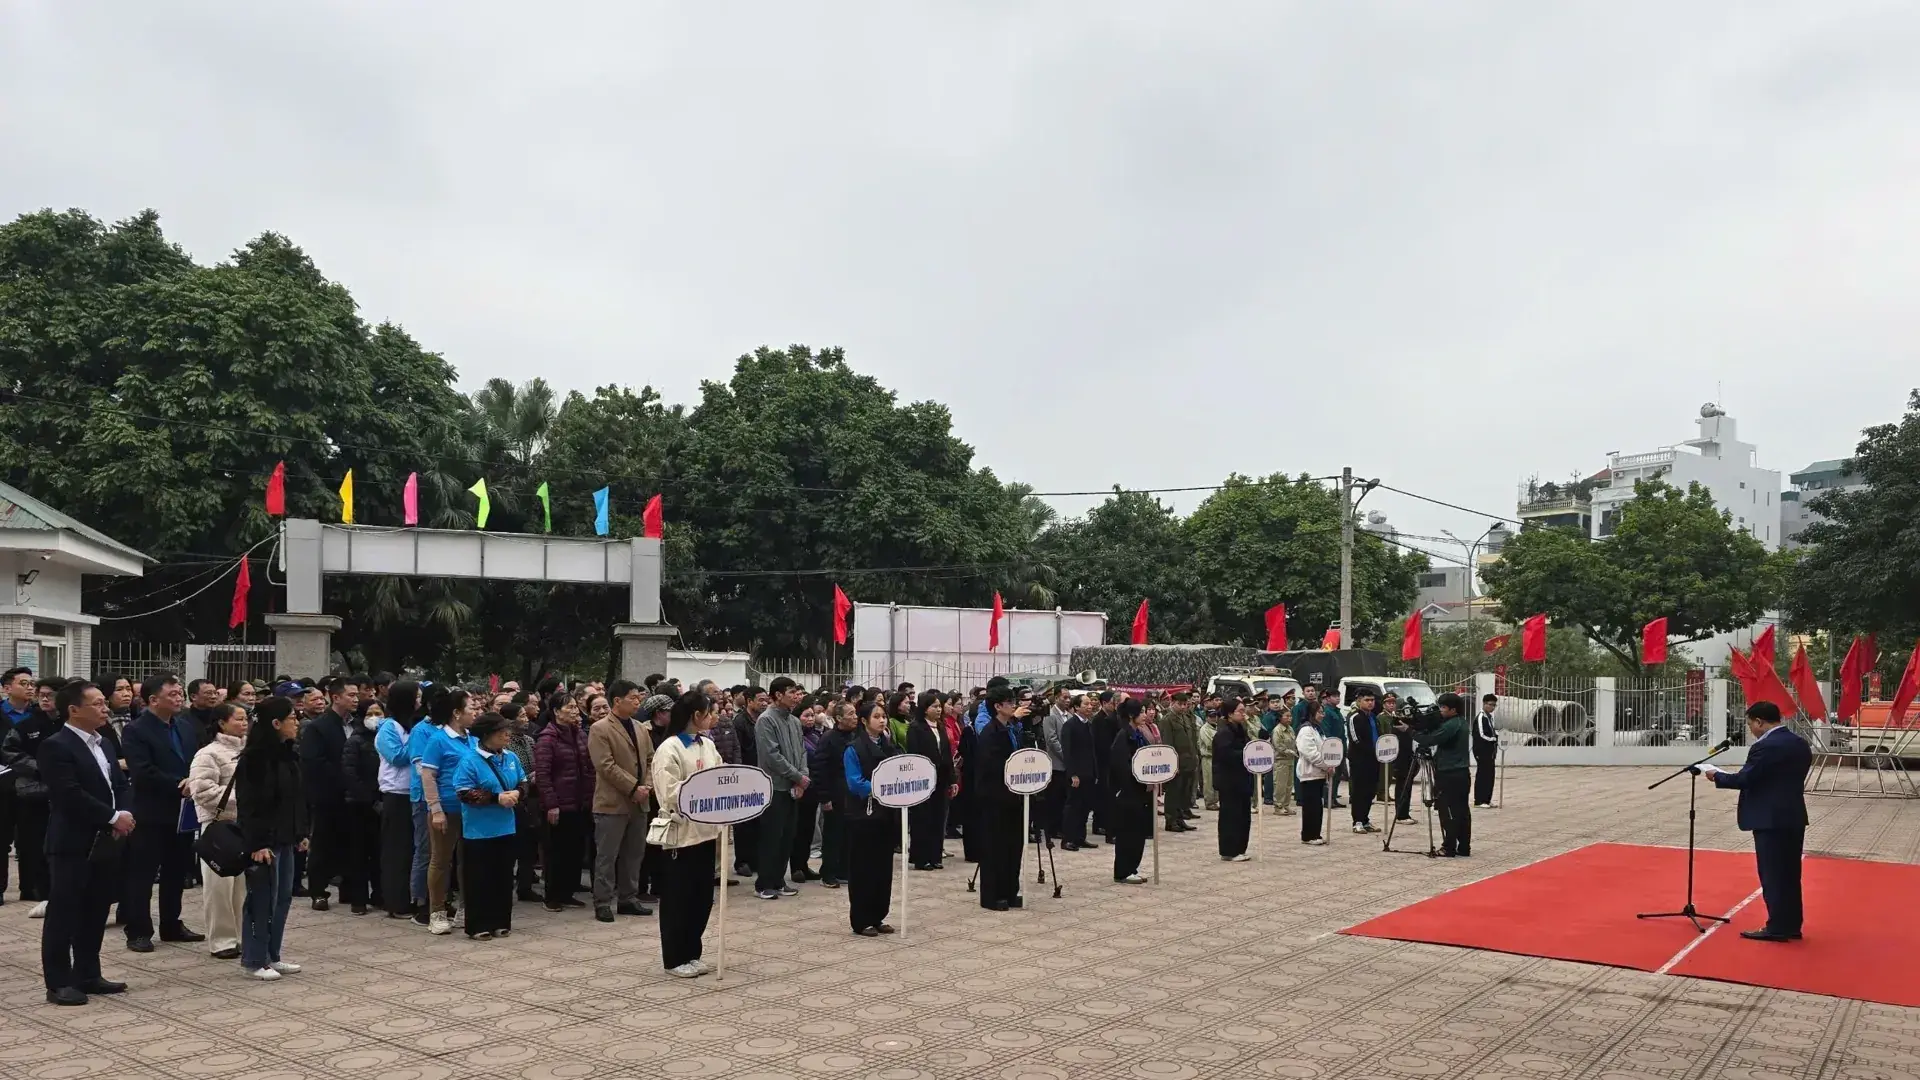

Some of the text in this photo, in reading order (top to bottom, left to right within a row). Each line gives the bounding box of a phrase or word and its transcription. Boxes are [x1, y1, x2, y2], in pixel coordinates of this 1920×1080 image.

[899, 760, 914, 771] KHỐI
[718, 772, 739, 785] KHỐI
[689, 790, 764, 814] ỦY BAN MTTQVN PHƯỜNG
